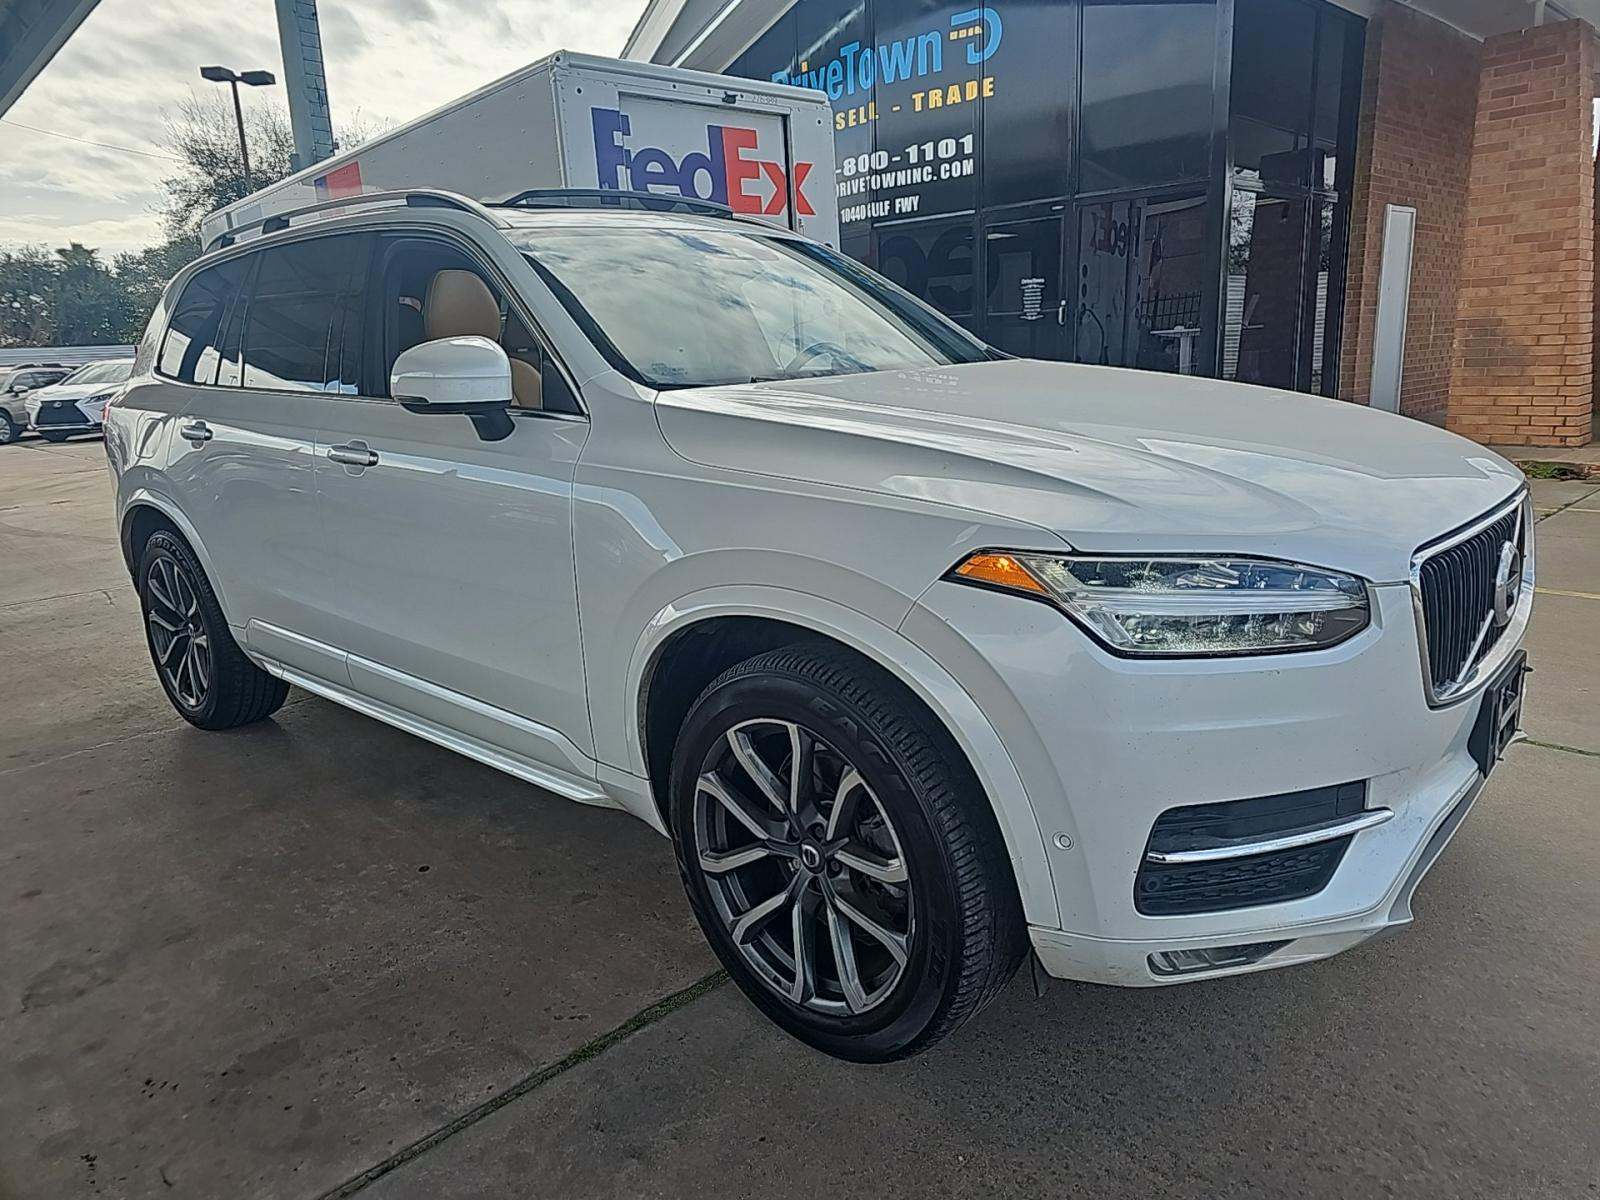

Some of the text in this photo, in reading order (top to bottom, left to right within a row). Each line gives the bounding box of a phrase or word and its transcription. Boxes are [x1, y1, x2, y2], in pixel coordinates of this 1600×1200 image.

[771, 30, 943, 101] iveTown
[835, 101, 880, 131] SELL
[911, 76, 994, 112] TRADE
[591, 107, 816, 215] FedEx
[840, 204, 866, 224] 10440
[895, 195, 920, 214] FWY
